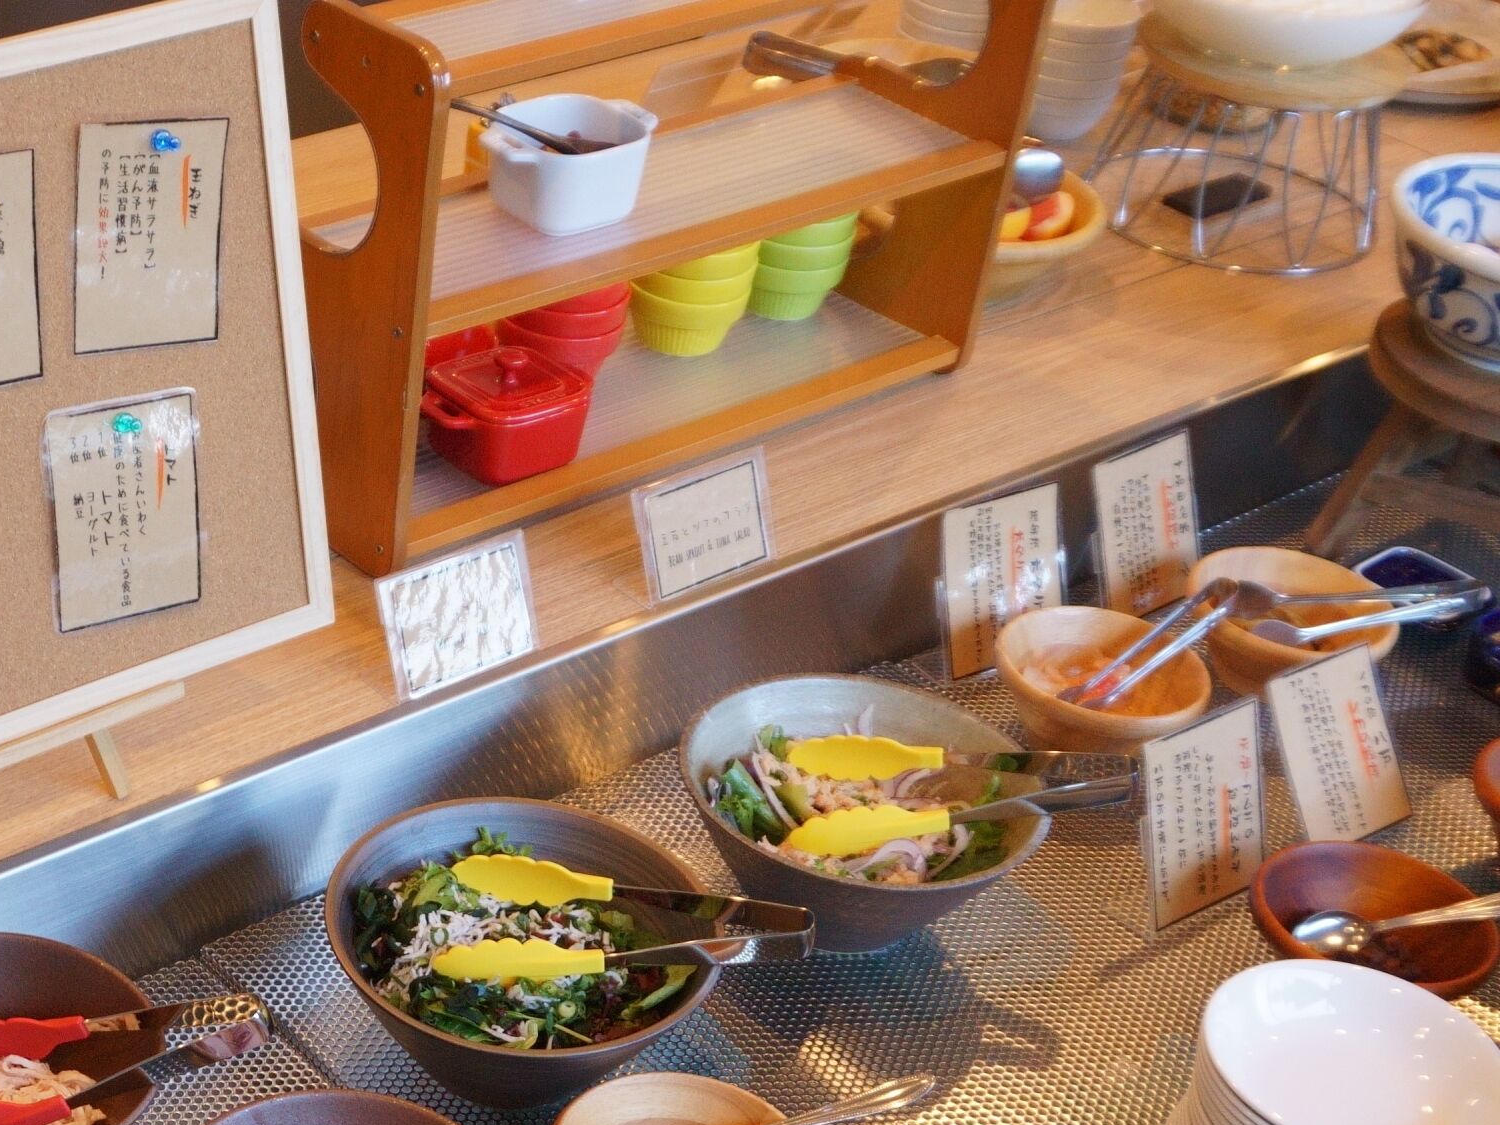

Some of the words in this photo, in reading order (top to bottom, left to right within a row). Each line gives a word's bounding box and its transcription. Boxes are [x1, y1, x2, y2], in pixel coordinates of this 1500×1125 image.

[189, 168, 202, 219] 玉ねぎ
[668, 554, 683, 568] BEAN
[716, 535, 731, 548] TUNA
[734, 526, 751, 542] SALAD
